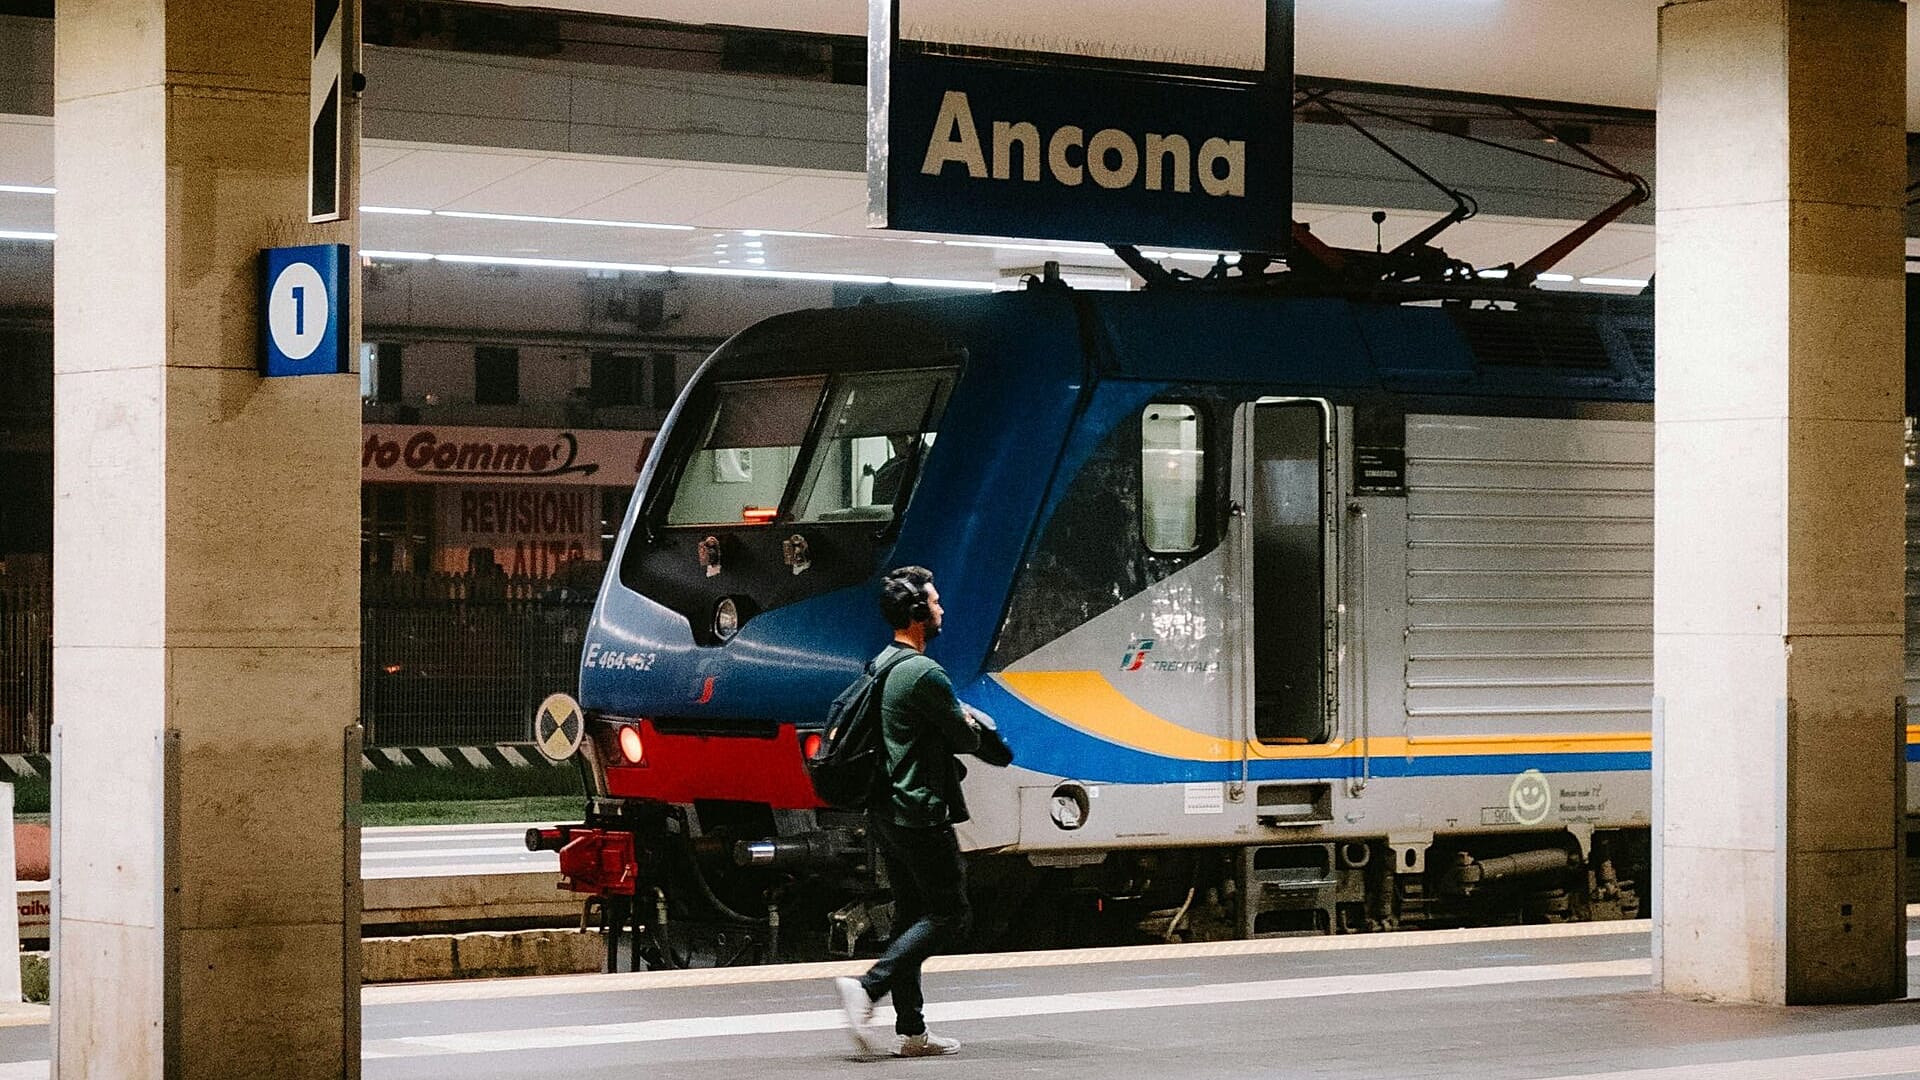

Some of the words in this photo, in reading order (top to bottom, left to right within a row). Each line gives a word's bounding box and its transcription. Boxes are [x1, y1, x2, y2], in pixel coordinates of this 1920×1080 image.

[921, 90, 1246, 197] Ancona
[291, 286, 304, 335] 1
[460, 490, 586, 534] REVISIONI
[584, 643, 601, 667] E
